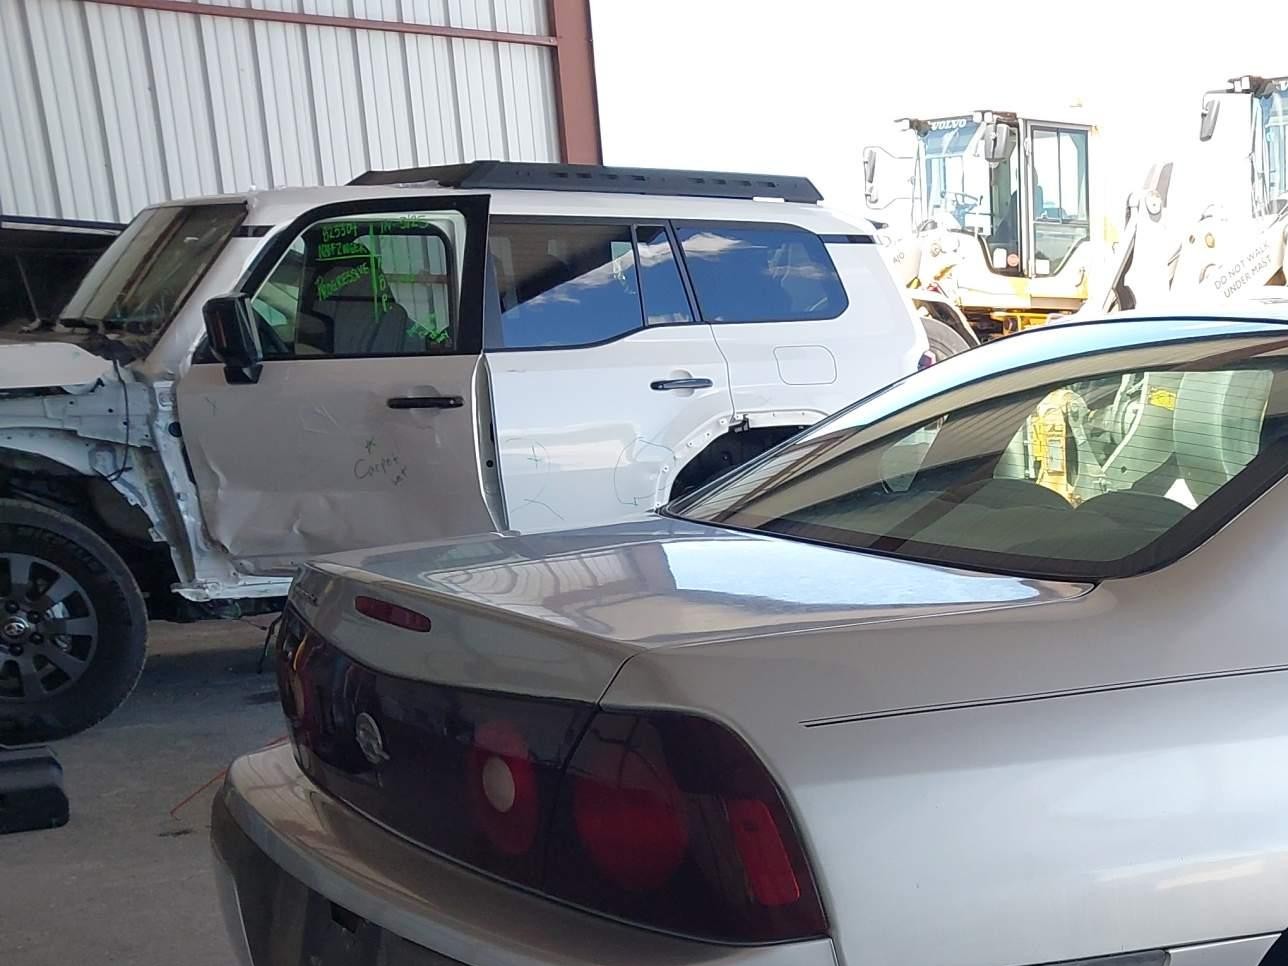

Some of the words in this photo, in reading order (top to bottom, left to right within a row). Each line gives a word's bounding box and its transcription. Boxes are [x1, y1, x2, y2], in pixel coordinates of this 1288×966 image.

[929, 118, 967, 131] VOLVO
[1214, 274, 1228, 290] DO
[1227, 259, 1245, 279] NOT
[1223, 271, 1252, 299] UNDER
[1251, 254, 1272, 276] MAST
